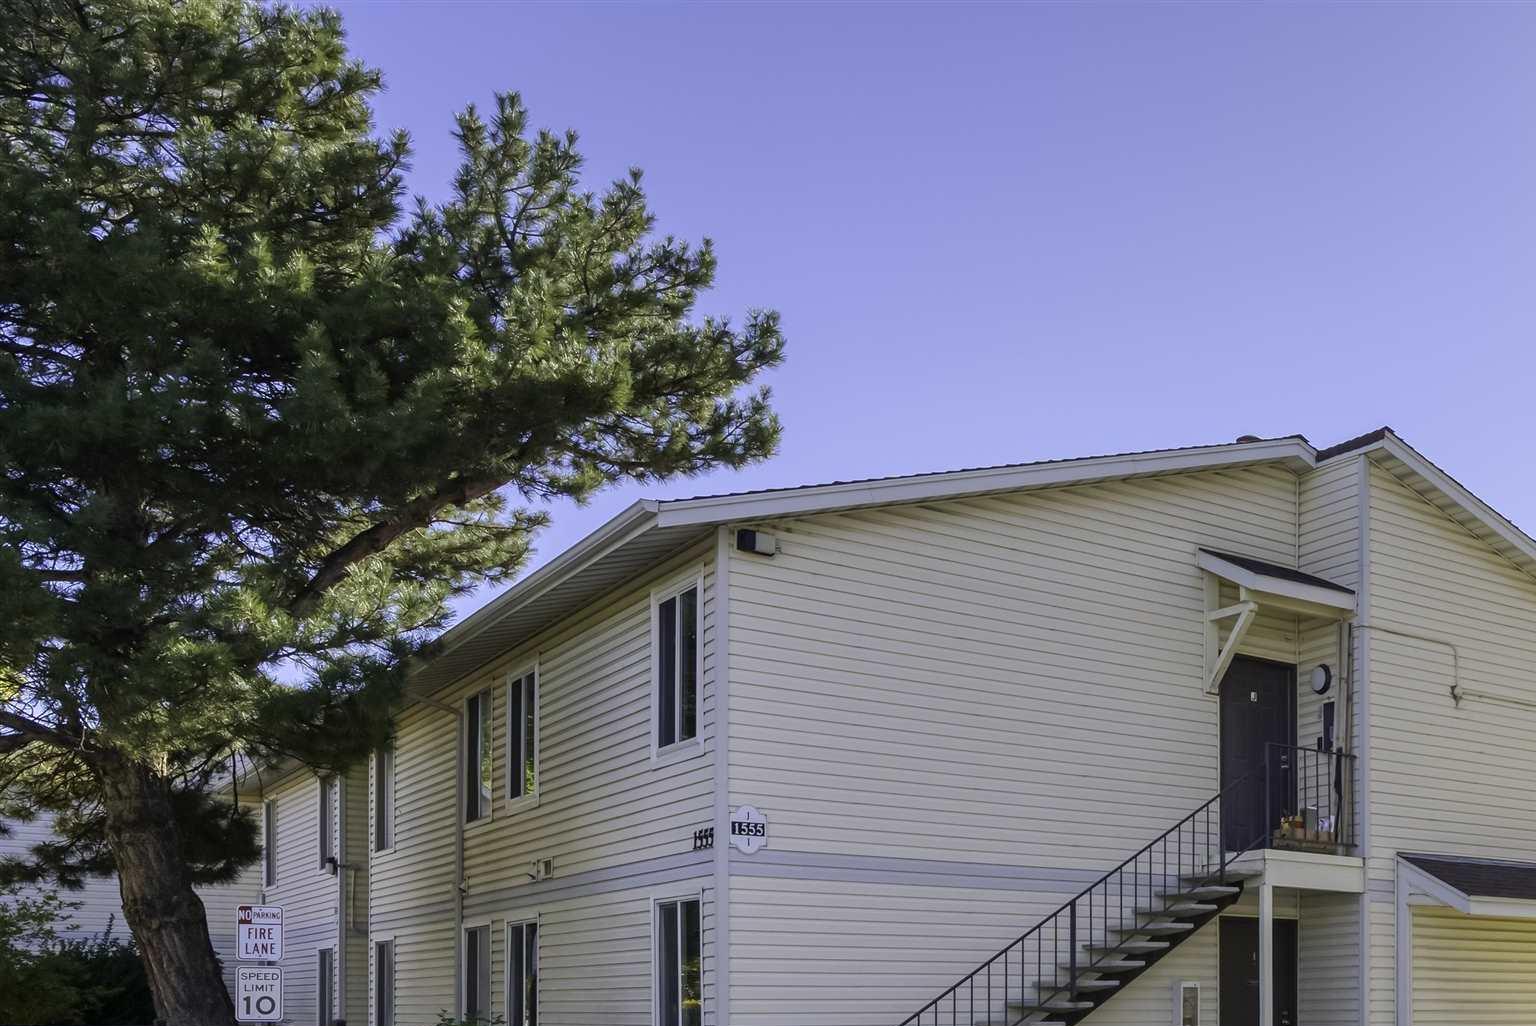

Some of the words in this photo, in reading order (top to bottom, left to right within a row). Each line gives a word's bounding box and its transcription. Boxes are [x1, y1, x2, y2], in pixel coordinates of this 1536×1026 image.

[734, 822, 764, 836] 1555
[693, 827, 714, 851] 1555
[239, 909, 252, 921] NO
[253, 911, 280, 921] PARKING
[247, 927, 274, 940] FIRE
[245, 943, 276, 954] LANE
[240, 972, 279, 981] SPEED
[244, 984, 275, 992] LIMIT
[243, 995, 276, 1015] 10
